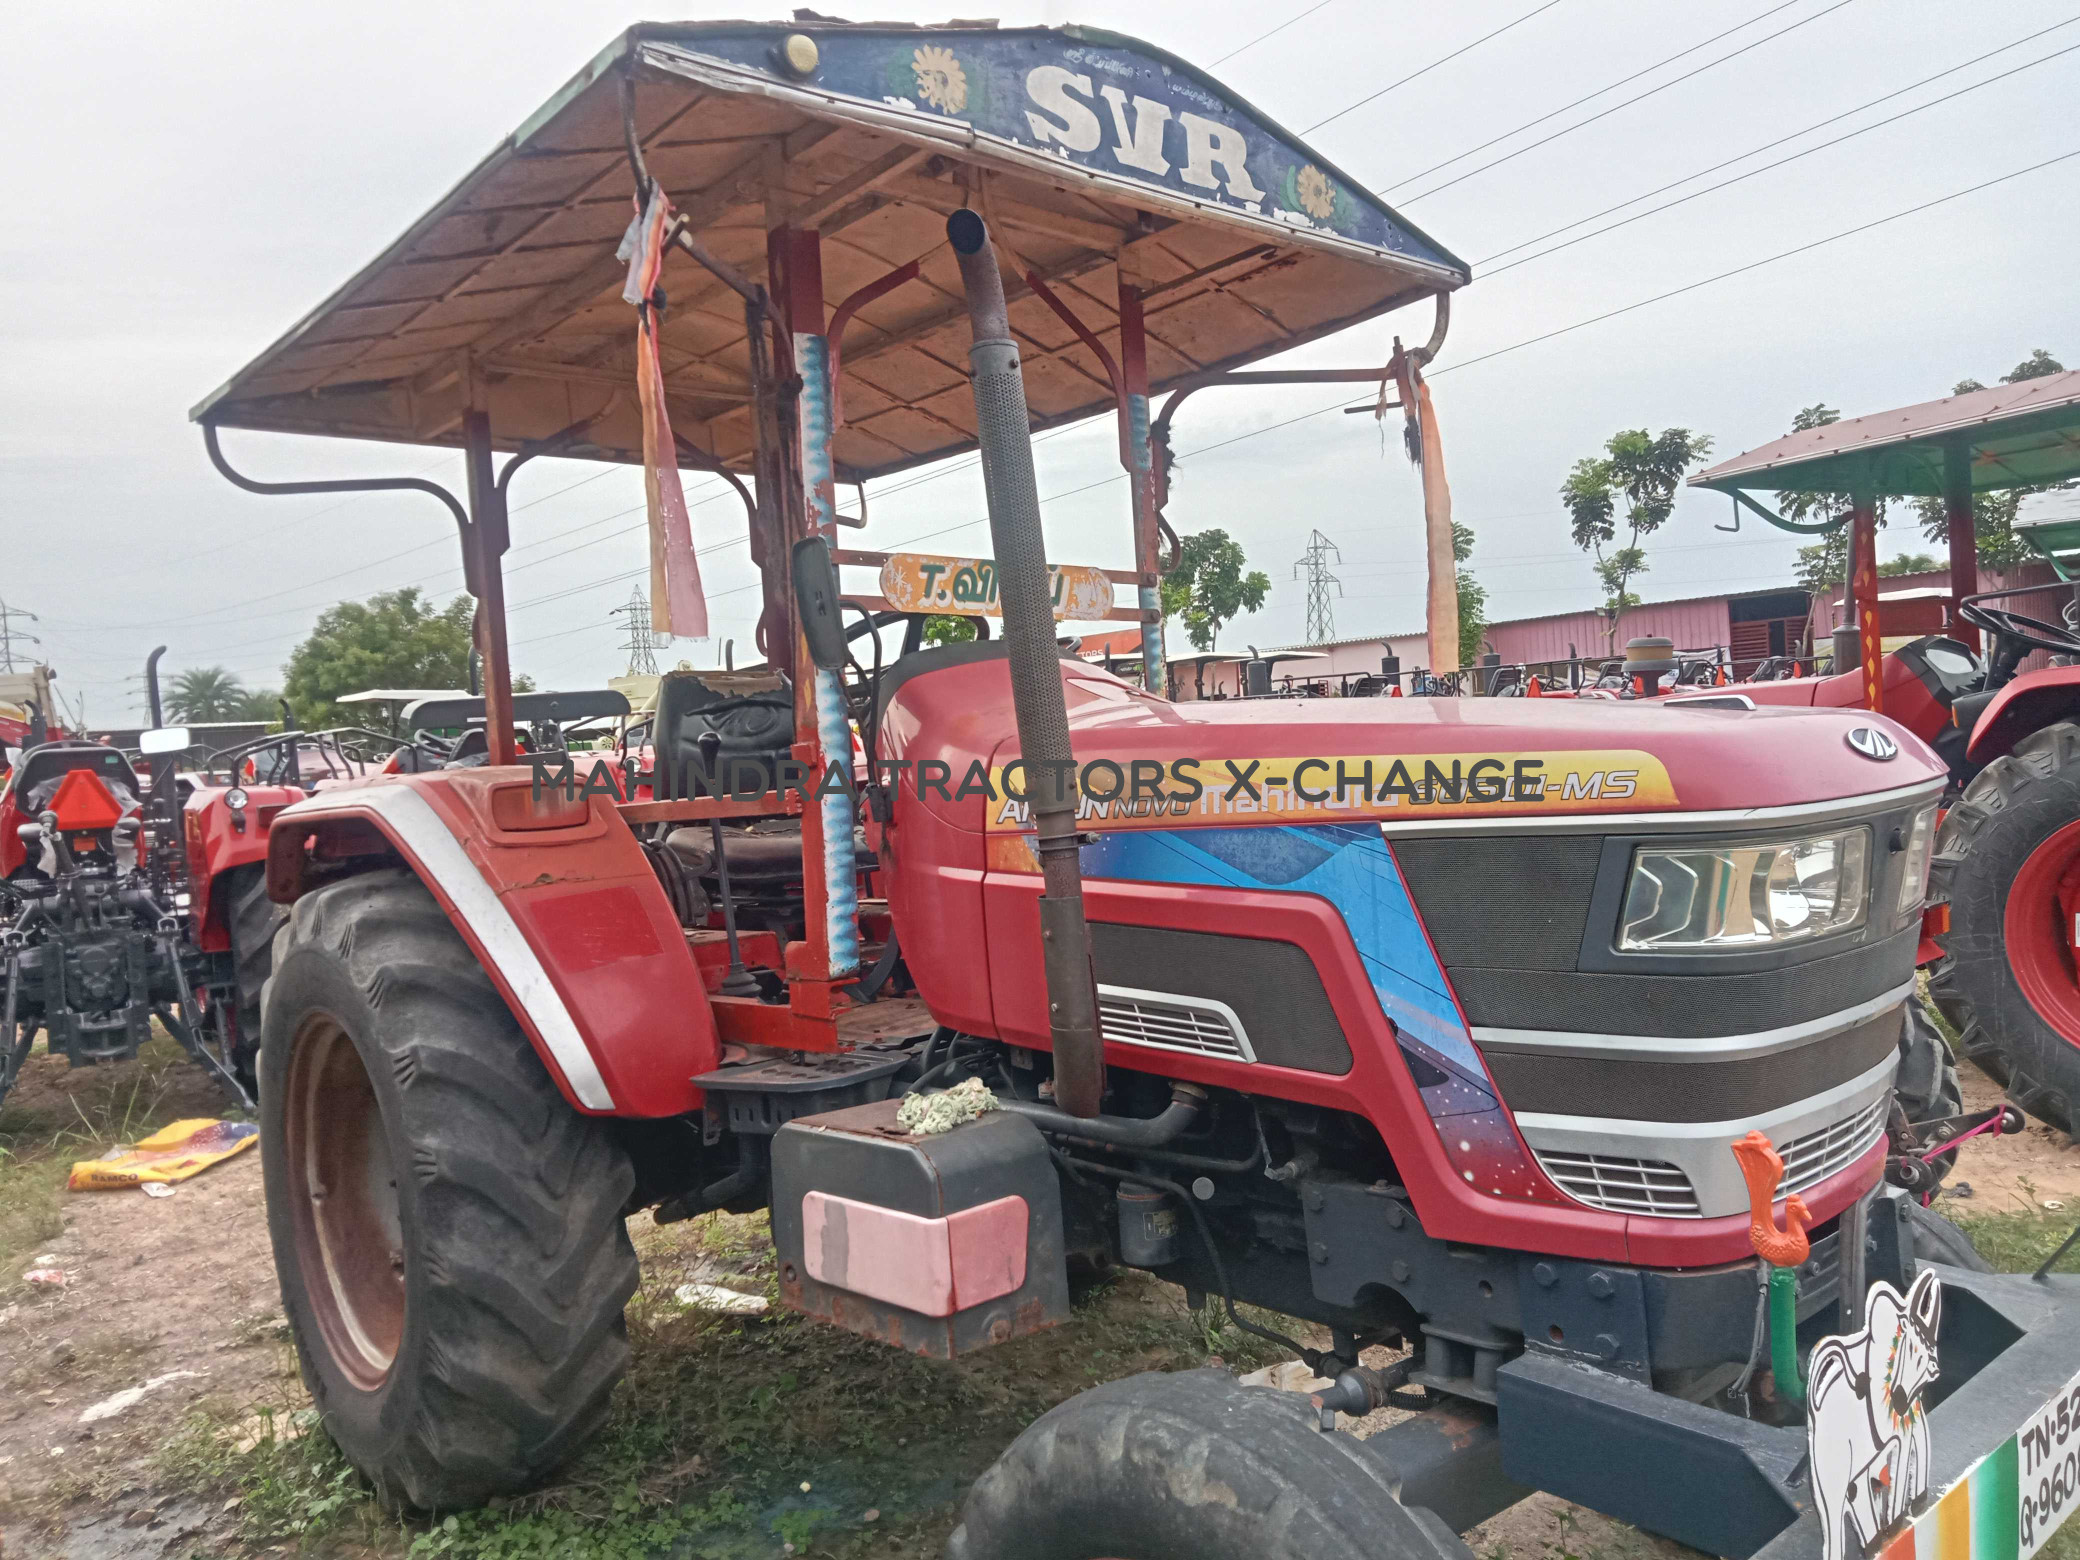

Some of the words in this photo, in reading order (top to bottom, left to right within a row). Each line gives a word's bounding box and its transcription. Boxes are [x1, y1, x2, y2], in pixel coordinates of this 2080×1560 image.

[1024, 65, 1267, 203] SVR
[1113, 793, 1192, 819] NOVO
[91, 1173, 138, 1182] RAMCO
